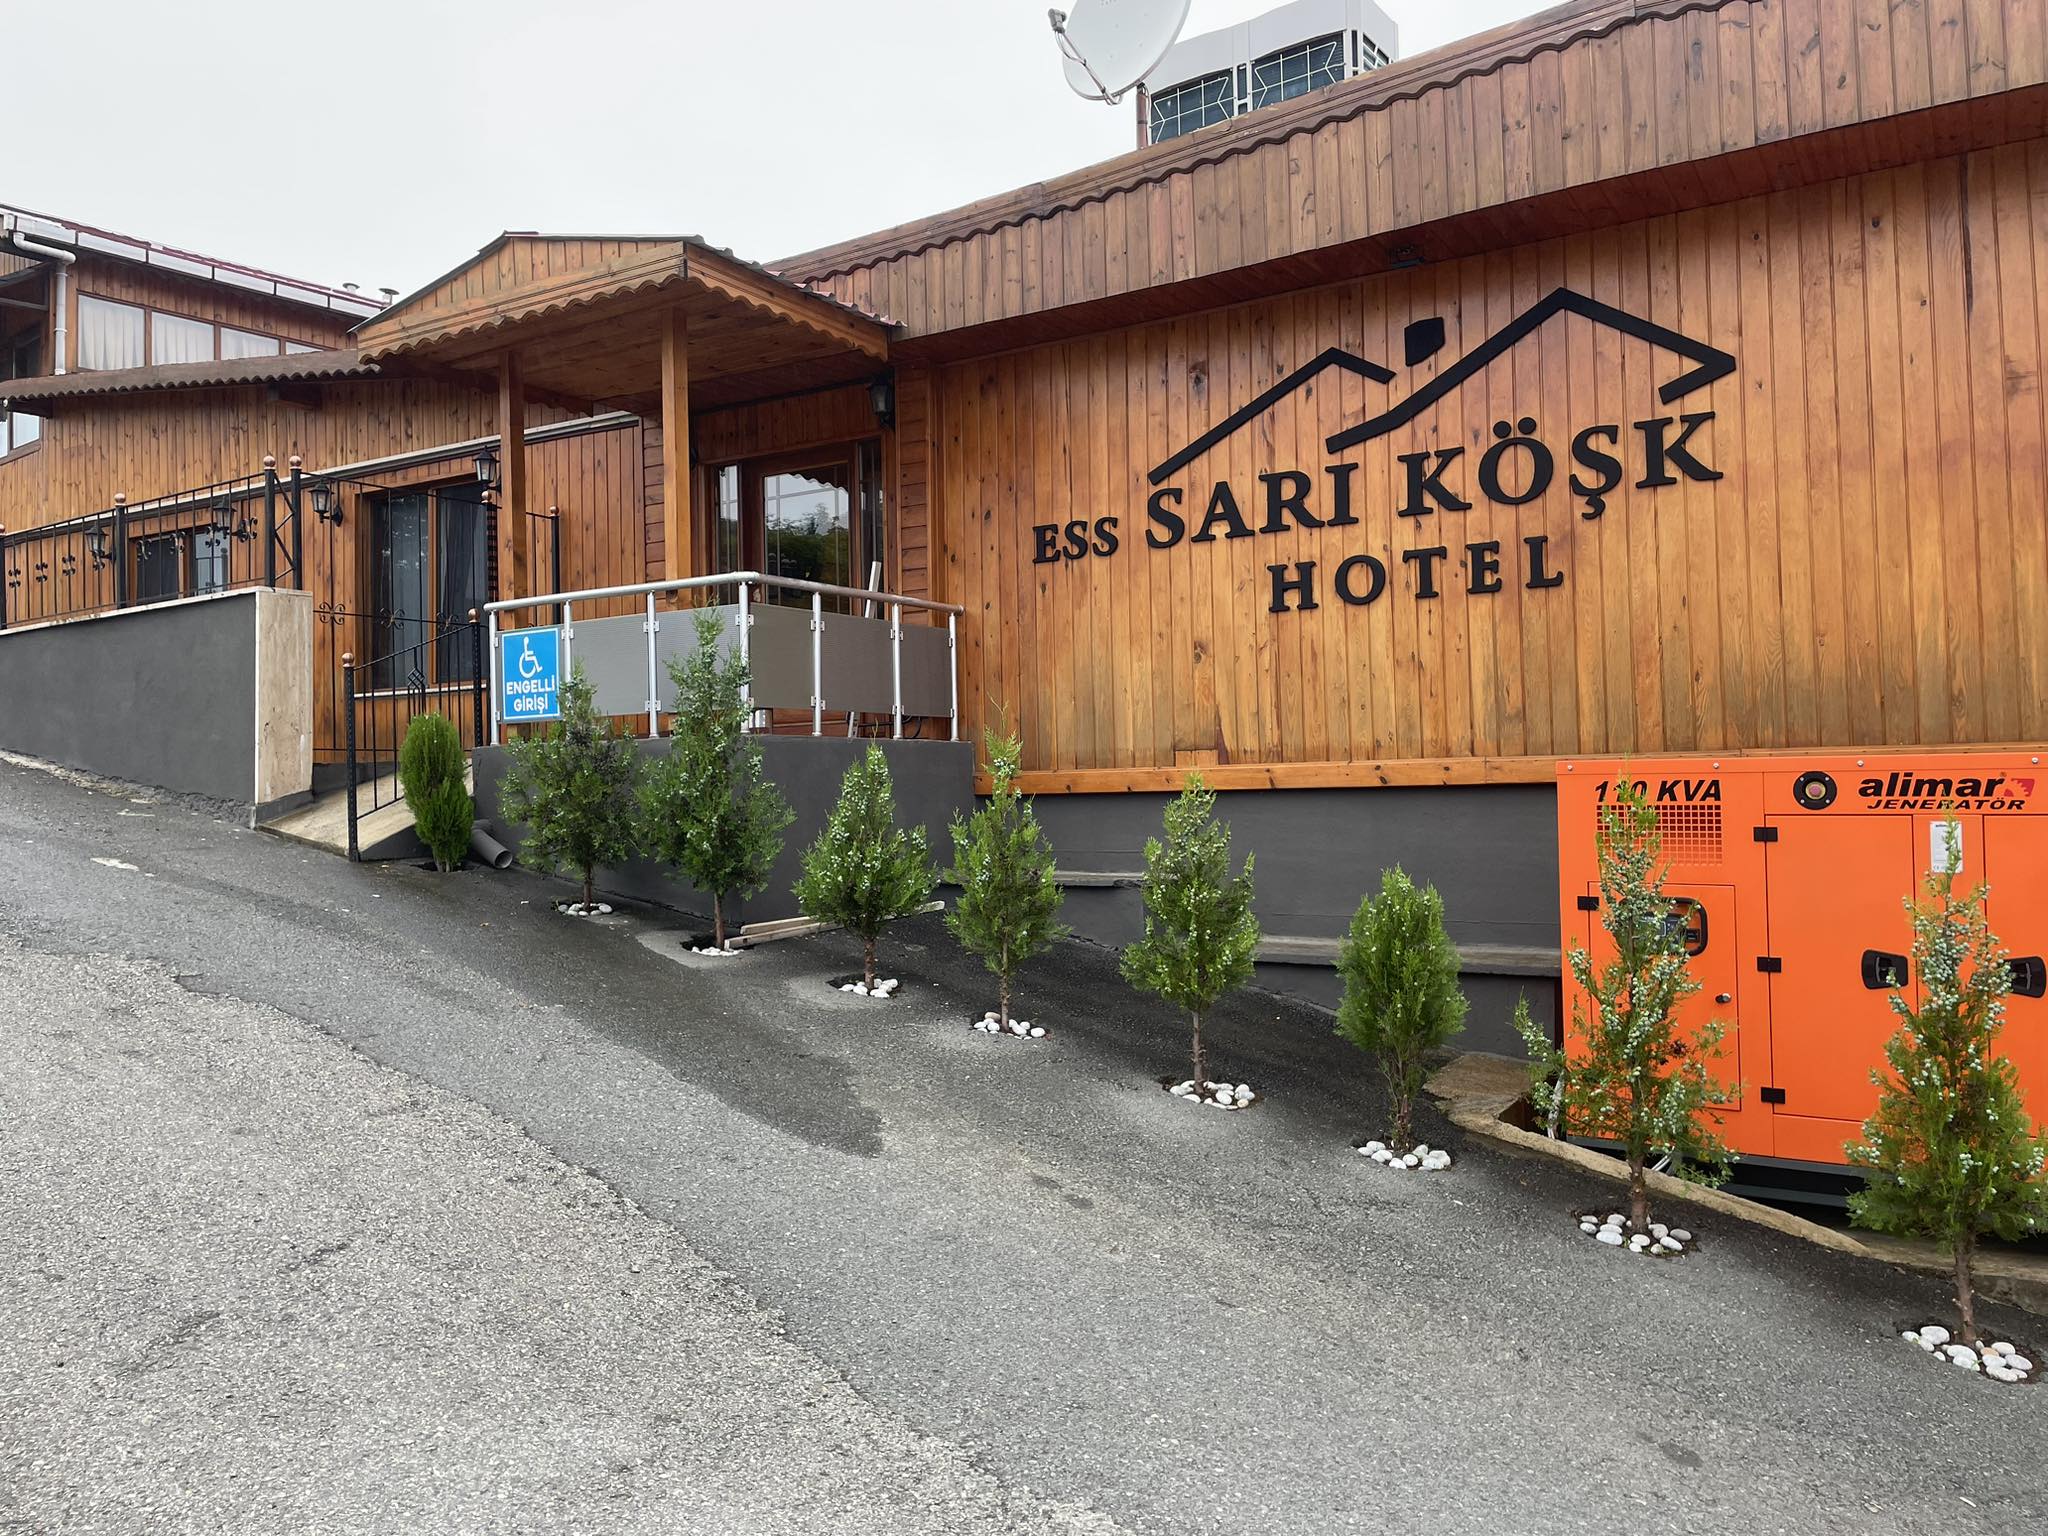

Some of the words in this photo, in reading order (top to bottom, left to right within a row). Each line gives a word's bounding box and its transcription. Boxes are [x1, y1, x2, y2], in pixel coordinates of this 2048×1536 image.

[1033, 517, 1119, 564] ESS
[1146, 462, 1359, 549] SARI
[1398, 411, 1724, 521] KÖŞK
[1267, 536, 1564, 613] HOTEL
[506, 675, 555, 695] ENGELLİ
[513, 693, 548, 714] GİRİŞİ
[1656, 779, 1721, 802] KVA
[1858, 772, 2004, 797] alimar
[1867, 797, 2026, 810] JENERATÖR
